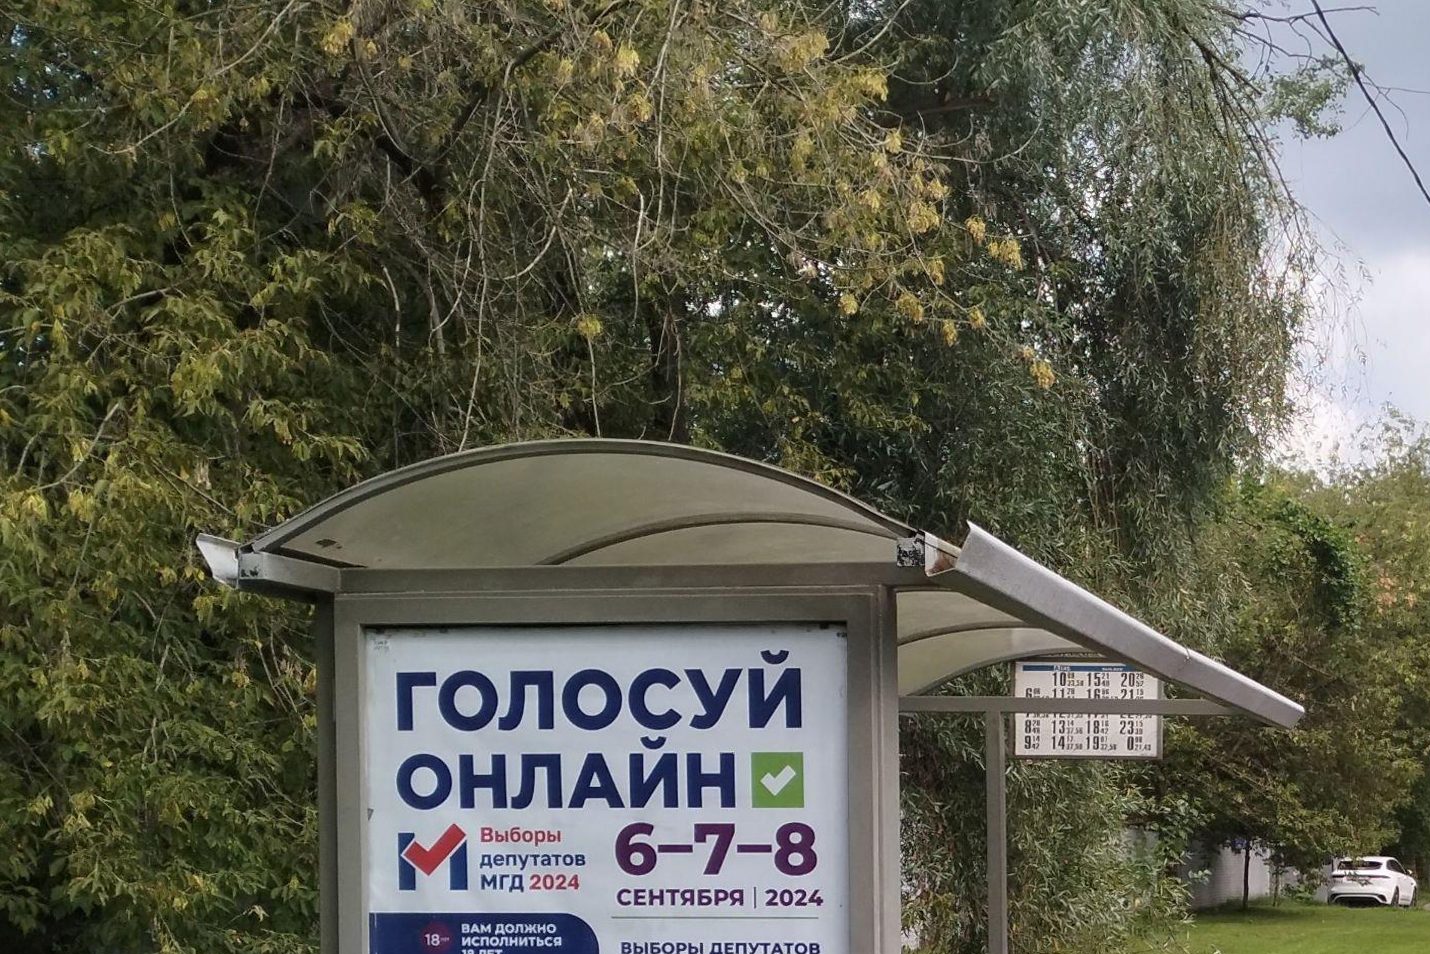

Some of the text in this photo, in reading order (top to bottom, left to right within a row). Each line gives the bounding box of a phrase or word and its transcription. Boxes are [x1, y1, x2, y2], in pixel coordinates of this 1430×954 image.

[1052, 672, 1067, 687] 10
[1087, 672, 1101, 687] 15
[1121, 672, 1135, 687] 20
[396, 649, 802, 732] ГОЛОСУЙ
[1025, 719, 1032, 734] 8
[1052, 720, 1065, 734] 13
[1087, 720, 1100, 734] 18
[1120, 720, 1134, 735] 23
[1025, 735, 1031, 750] 9
[1052, 736, 1065, 750] 14
[1086, 736, 1099, 750] 19
[1127, 736, 1134, 750] 0
[396, 736, 736, 810] ОНЛАЙН
[480, 827, 561, 845] Выборы
[480, 851, 586, 869] депутатов
[480, 874, 580, 893] МГД 2024
[617, 889, 823, 907] СЕНТЯБРЯ 2024
[461, 924, 556, 935] ВАМ ДОЛЖНО
[462, 937, 562, 947] ИСПОЛНИТЬСЯ
[621, 942, 703, 954] ВЫБОРЫ
